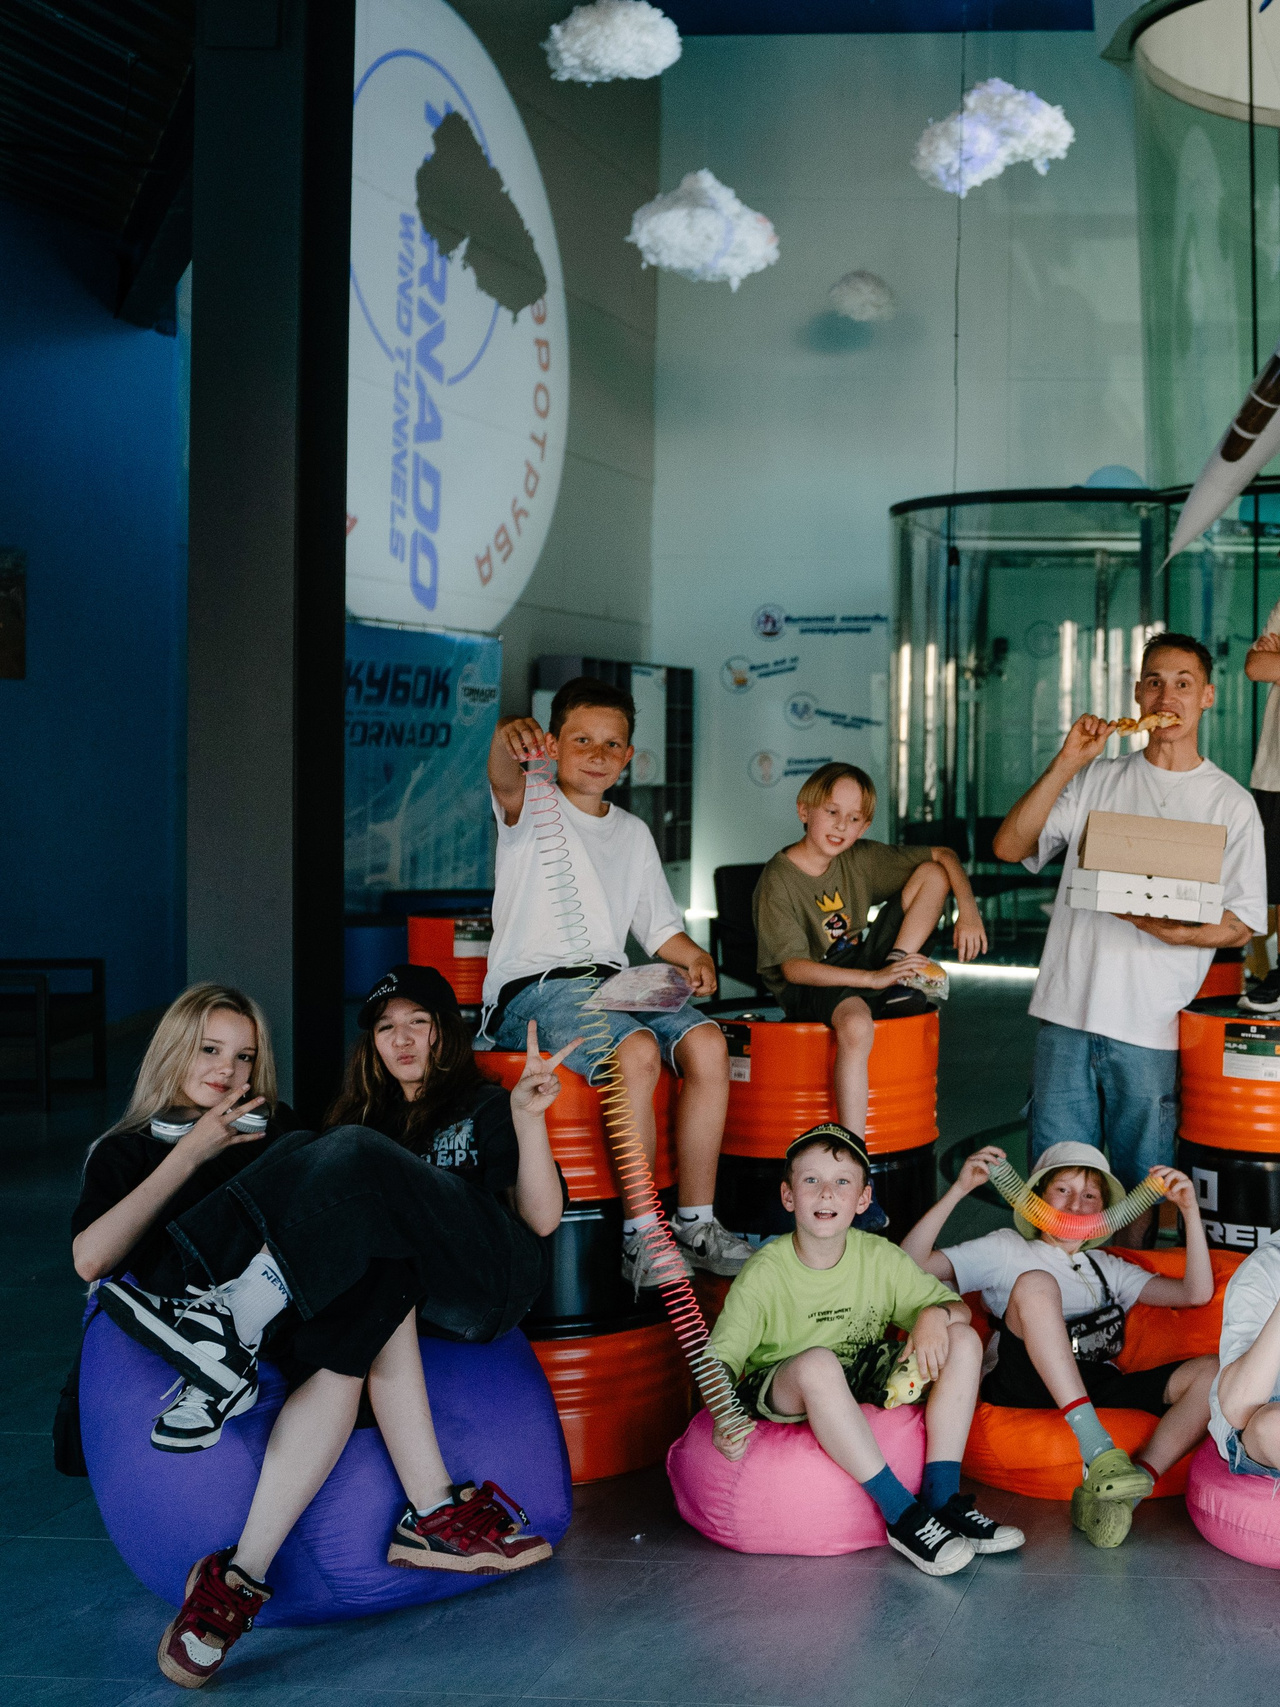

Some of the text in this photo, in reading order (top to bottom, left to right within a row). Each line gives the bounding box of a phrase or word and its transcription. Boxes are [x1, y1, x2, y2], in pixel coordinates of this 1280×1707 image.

[389, 212, 415, 563] WIND TUNNELS
[410, 100, 458, 612] RNADO
[475, 296, 550, 587] ЭРОТРУБА
[345, 660, 452, 709] КУБОК
[345, 721, 451, 747] ORNADO
